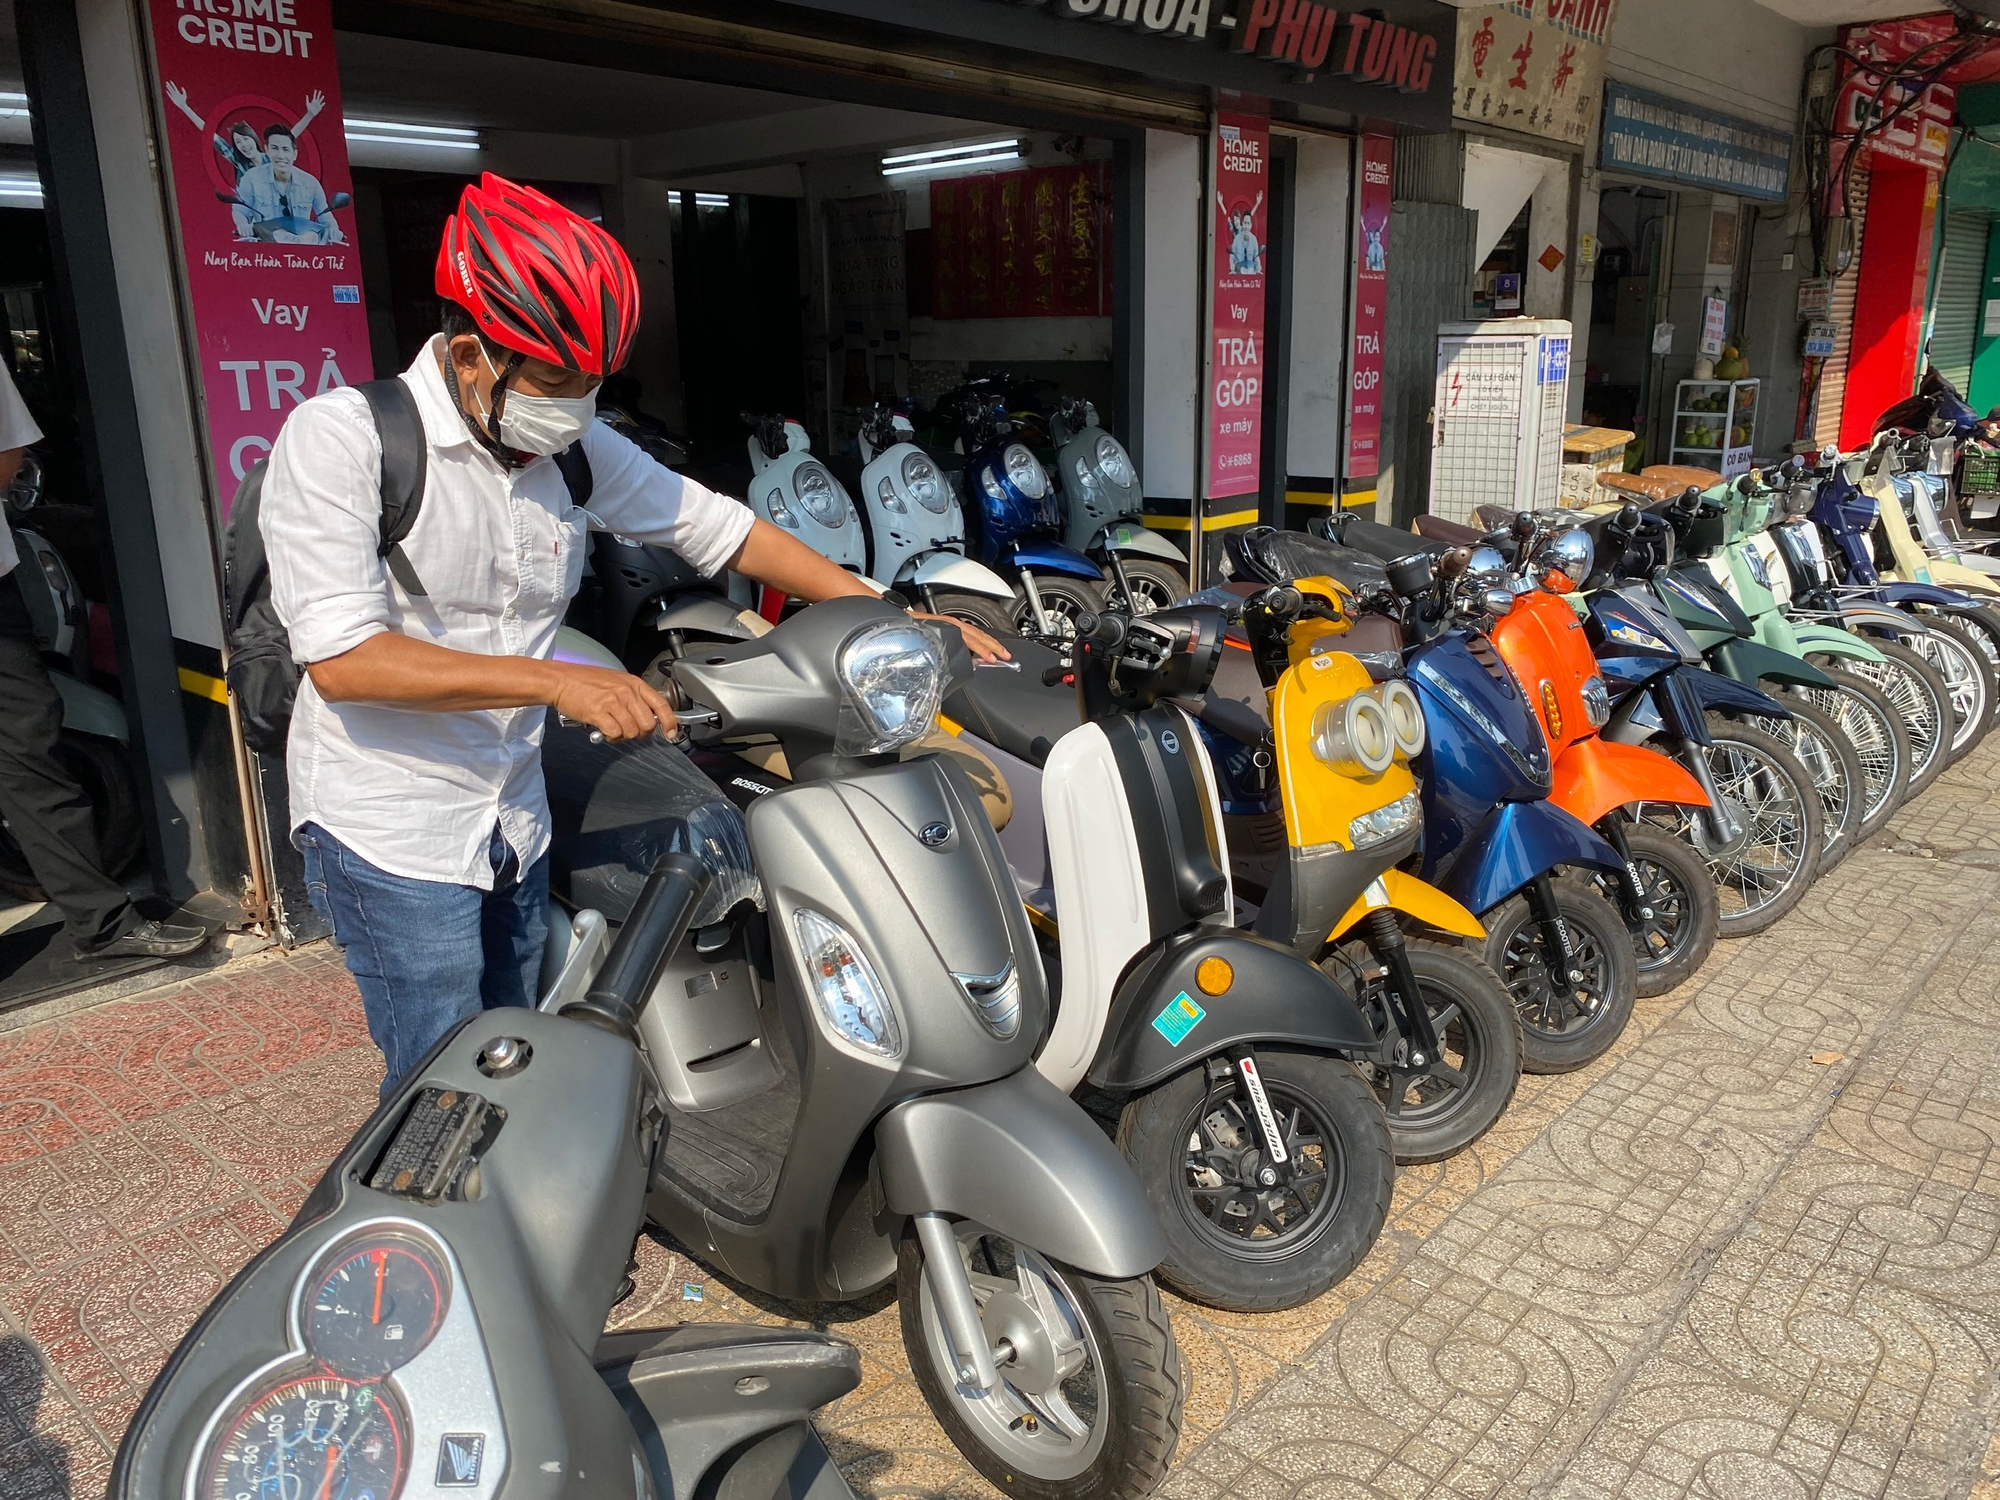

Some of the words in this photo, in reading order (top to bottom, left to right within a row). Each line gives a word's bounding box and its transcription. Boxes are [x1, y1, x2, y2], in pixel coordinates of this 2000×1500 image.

[178, 14, 313, 58] CREDIT
[1224, 139, 1259, 156] HOME
[1223, 155, 1263, 174] CREDIT
[1366, 161, 1388, 174] HOME
[1365, 172, 1389, 185] CREDIT
[205, 251, 228, 271] Nay
[231, 252, 252, 268] Bạn
[254, 253, 282, 268] Hoàn
[283, 254, 310, 269] Toàn
[312, 255, 325, 269] Có
[325, 255, 346, 270] Thể
[457, 251, 473, 298] GOBEL
[251, 298, 309, 331] Vay
[1231, 304, 1248, 322] Vay
[1365, 304, 1375, 317] Vay
[1219, 331, 1258, 366] TRẢ
[1356, 331, 1380, 354] TRẢ
[219, 347, 349, 411] TRẢ
[1216, 372, 1258, 408] GÓP
[1354, 367, 1379, 390] GÓP
[1362, 403, 1375, 415] máy
[1220, 423, 1231, 434] xe
[1233, 417, 1252, 434] máy
[1627, 862, 1645, 897] SCOOTER
[1555, 919, 1574, 958] SCOOTER
[303, 1399, 322, 1423] 120
[268, 1414, 286, 1439] 100
[242, 1444, 260, 1465] 80
[467, 1438, 480, 1481] HONDA
